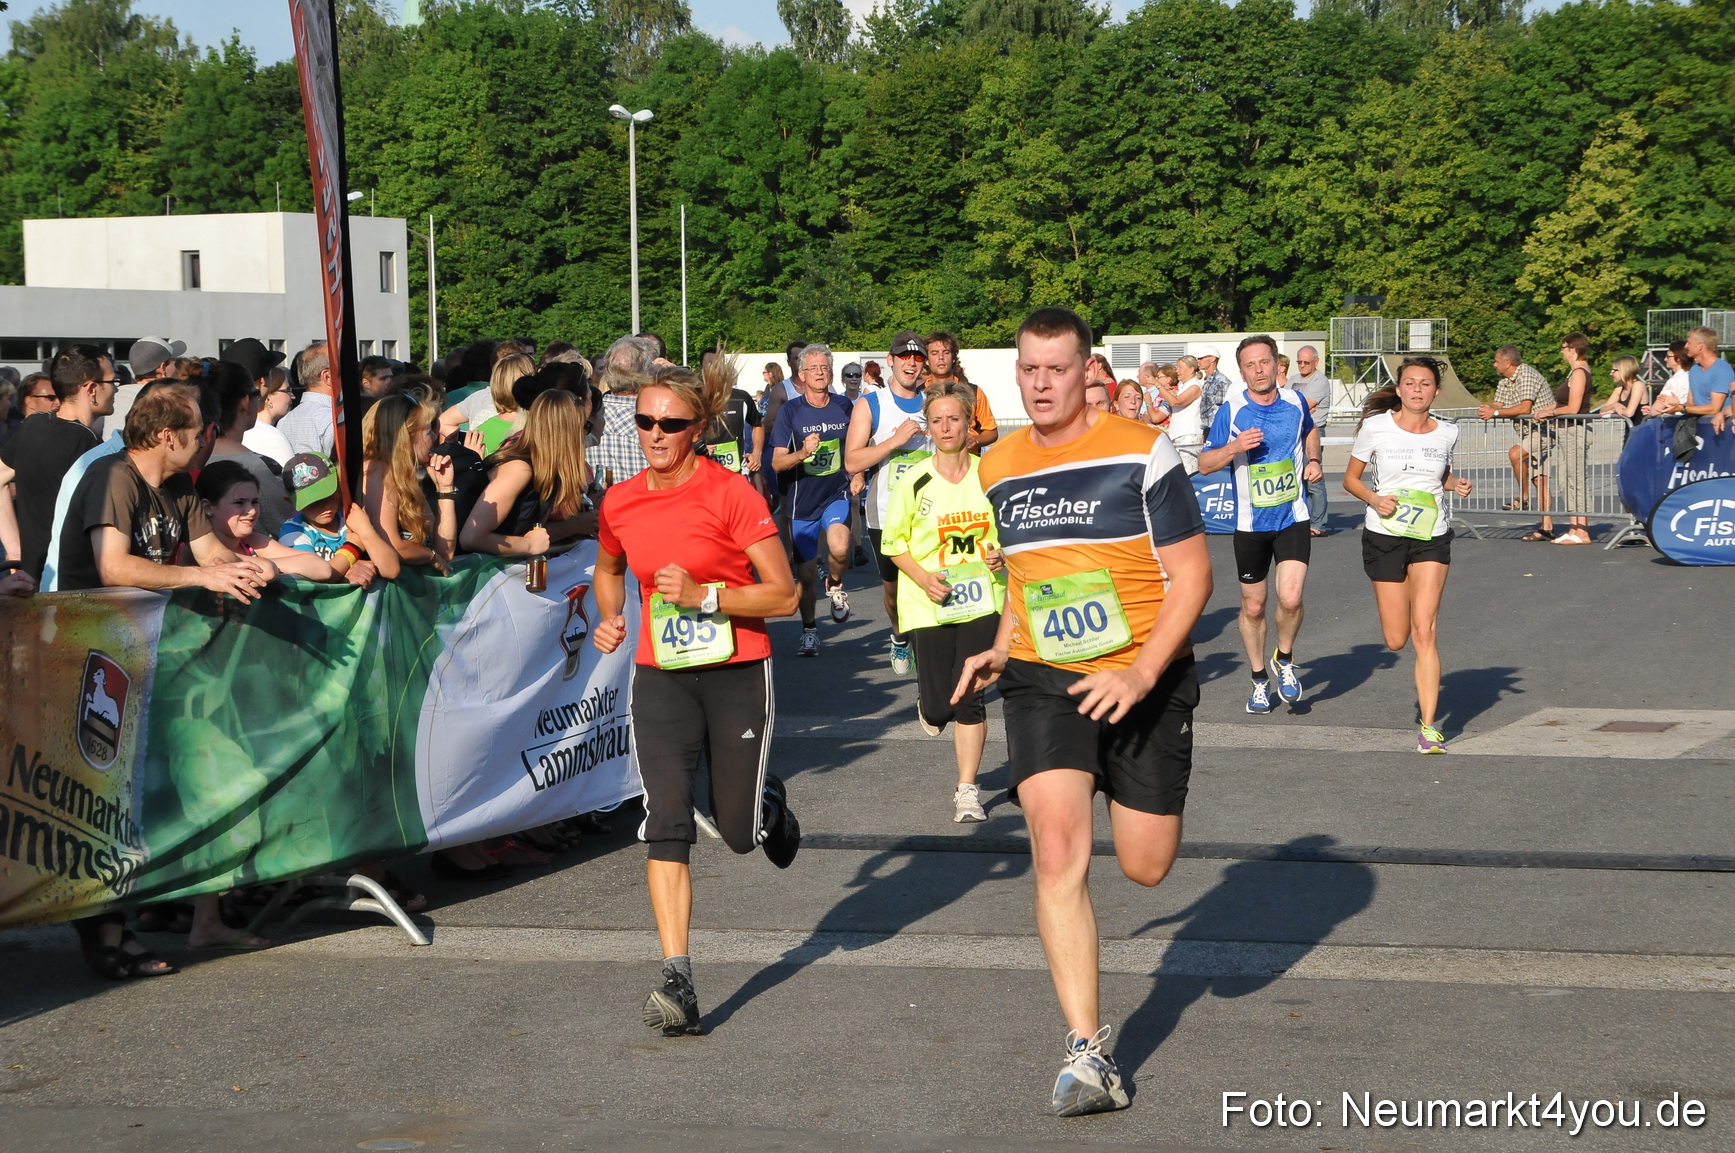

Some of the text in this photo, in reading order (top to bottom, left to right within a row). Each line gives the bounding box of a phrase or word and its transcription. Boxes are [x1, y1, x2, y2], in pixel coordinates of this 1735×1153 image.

[803, 422, 822, 434] EURO
[1252, 472, 1296, 497] 1042
[936, 510, 990, 527] Müller
[1010, 497, 1102, 522] Fischer
[1395, 504, 1424, 525] 27
[1016, 516, 1094, 530] AUTOMOBILE
[1693, 517, 1735, 536] Fis
[950, 534, 976, 555] M
[661, 612, 717, 648] 495
[1043, 600, 1108, 641] 400
[534, 685, 619, 739] Neumarkter
[87, 736, 108, 761] 1628
[520, 717, 630, 792] Lammsbräu
